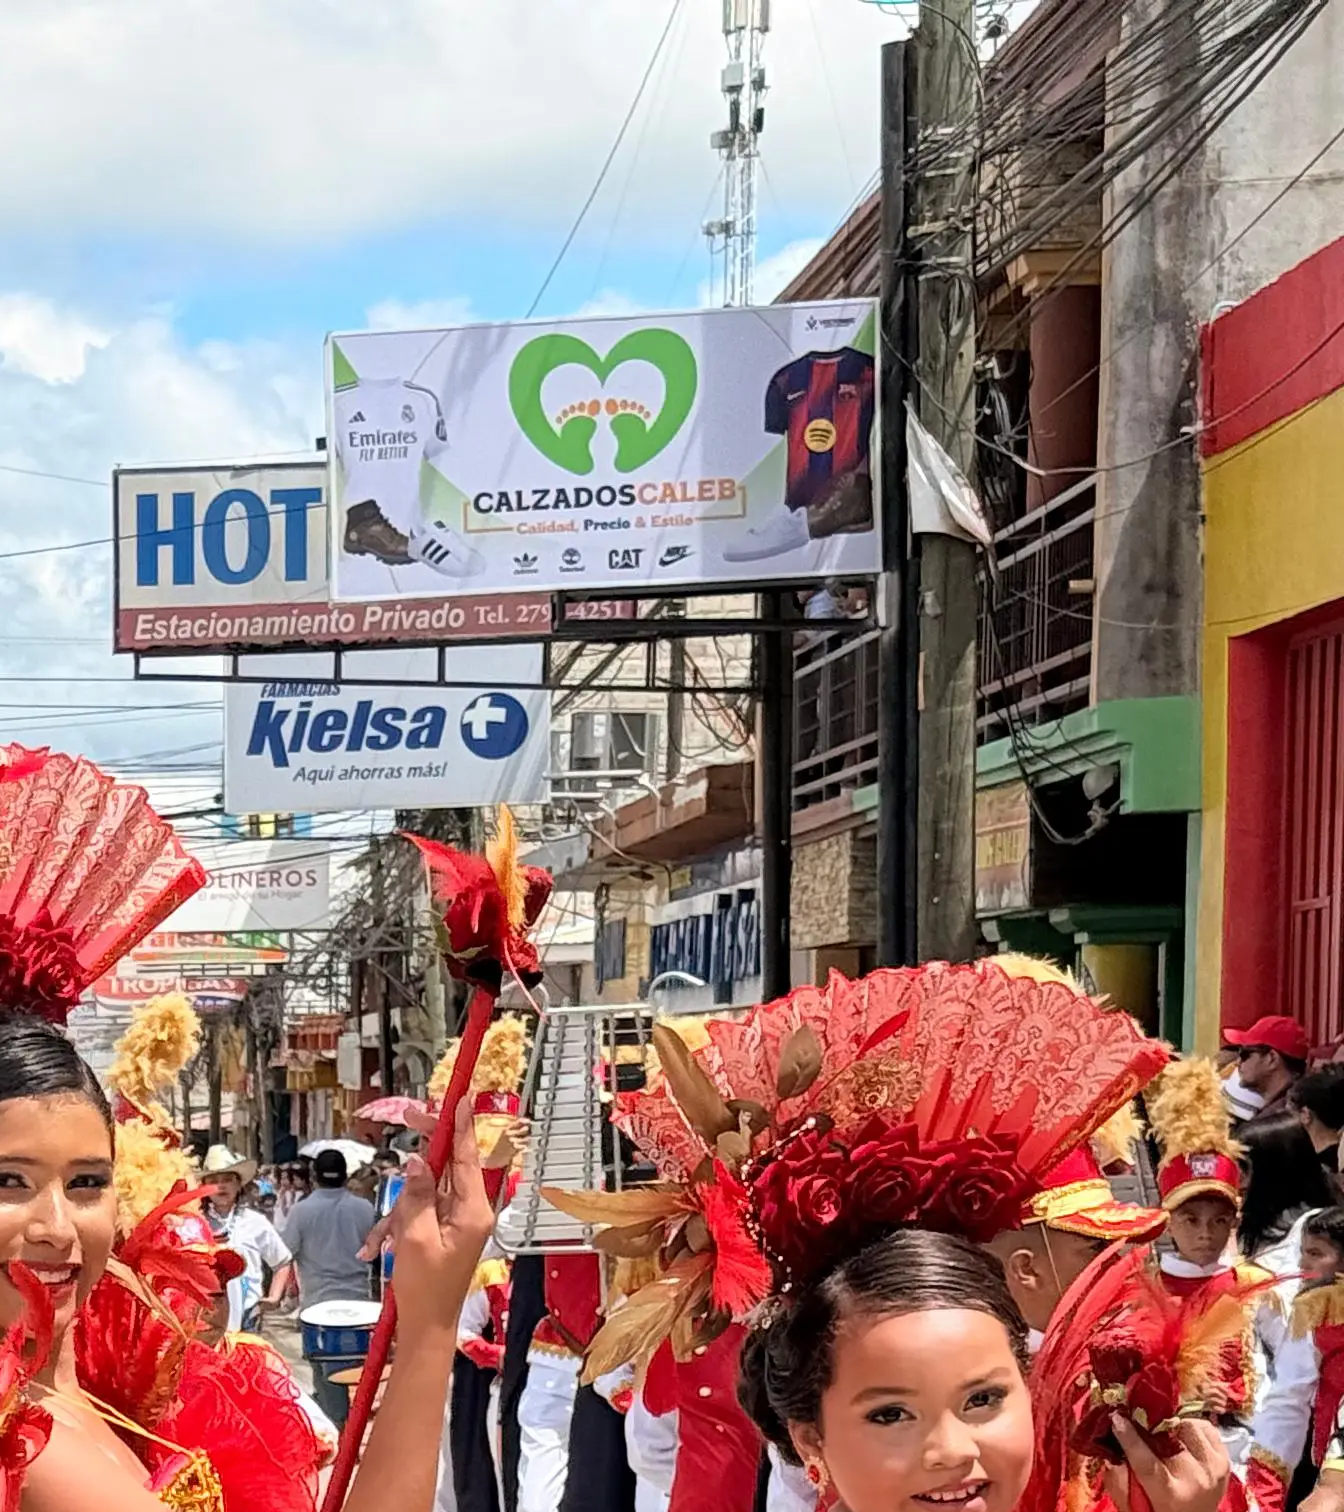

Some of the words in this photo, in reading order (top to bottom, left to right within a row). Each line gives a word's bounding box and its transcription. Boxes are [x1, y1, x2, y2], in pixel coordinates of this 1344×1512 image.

[349, 429, 418, 448] Emirates
[583, 518, 631, 532] Precio
[635, 516, 646, 529] &
[651, 514, 694, 528] Estilo
[608, 549, 646, 569] CAT
[134, 607, 355, 641] Estacionamiento
[362, 602, 465, 632] Privado
[337, 763, 403, 781] ahorras
[407, 760, 448, 779] más!
